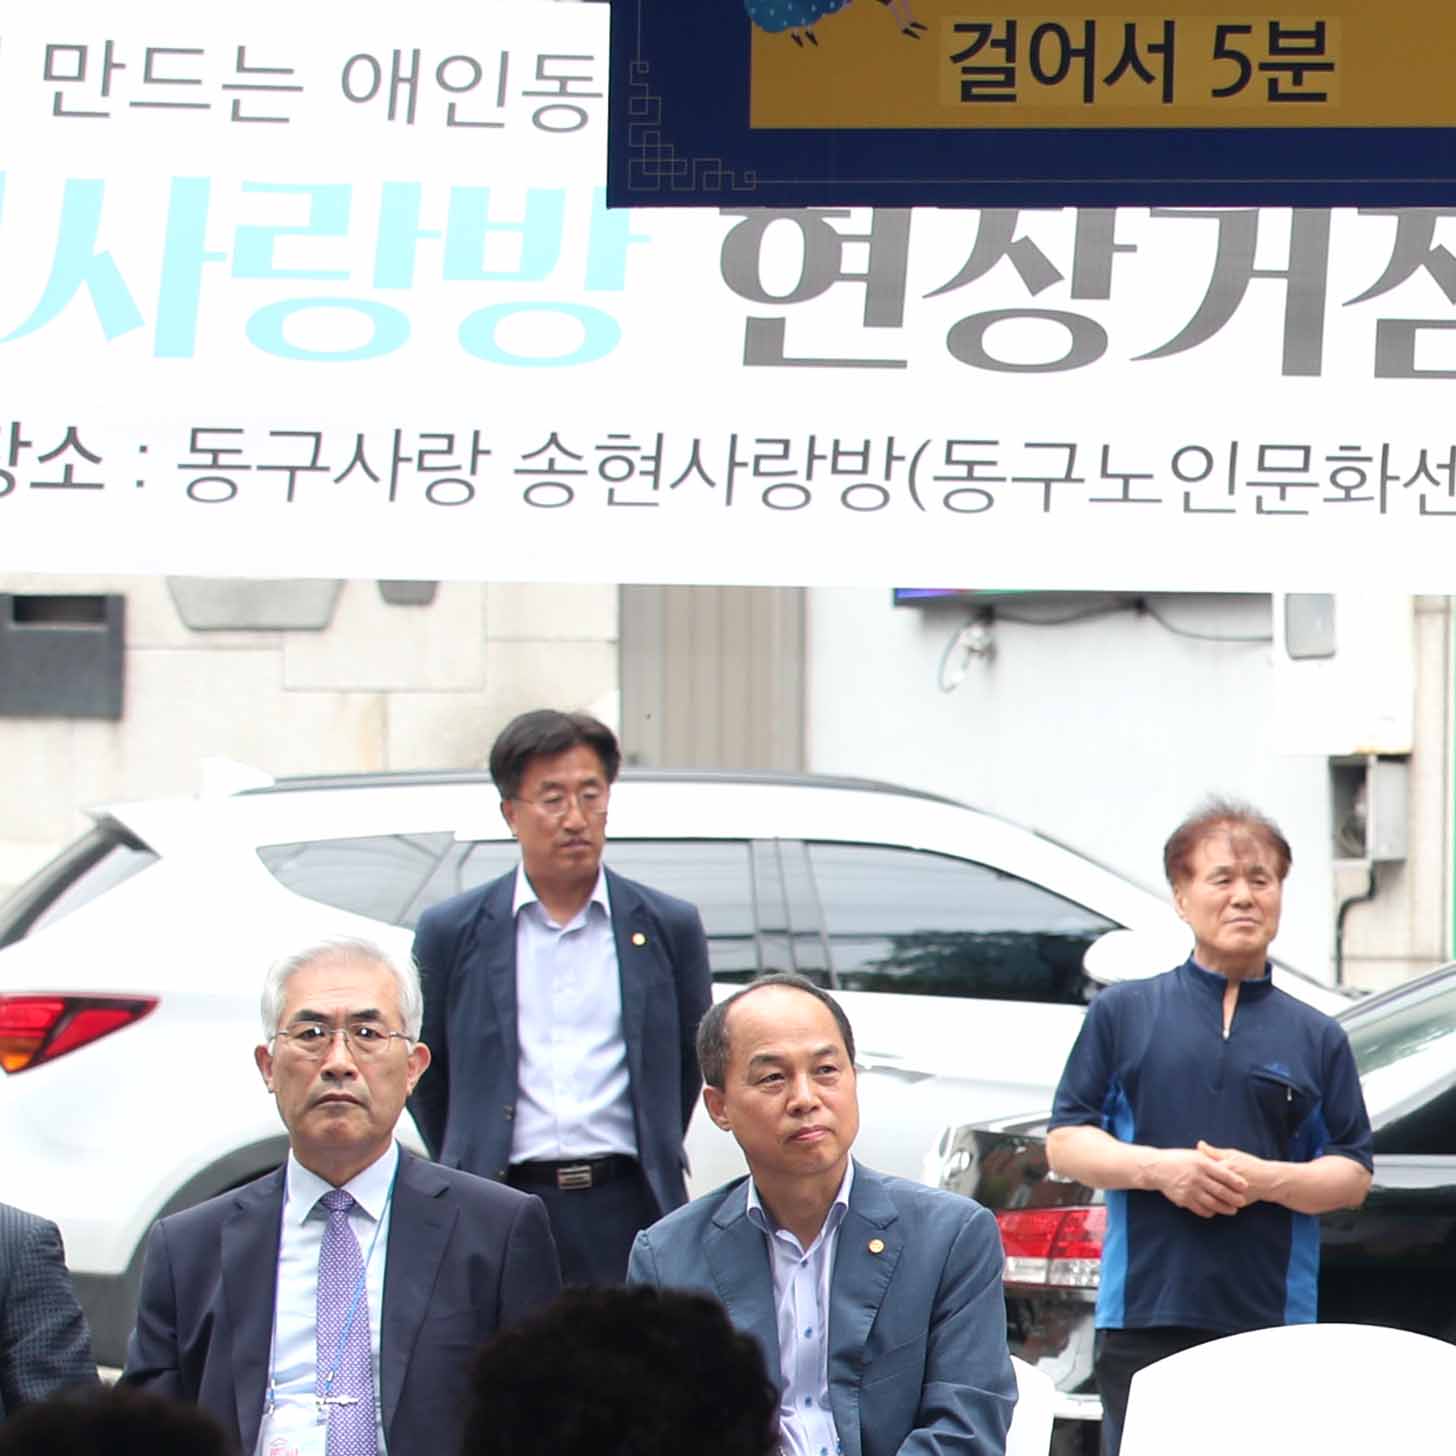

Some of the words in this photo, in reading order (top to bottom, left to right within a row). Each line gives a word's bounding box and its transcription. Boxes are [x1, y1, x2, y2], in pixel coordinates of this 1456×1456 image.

[43, 40, 304, 123] 만드는
[342, 49, 603, 132] 애인동
[946, 21, 1178, 105] 걸어서
[1209, 21, 1338, 105] 5분
[0, 172, 650, 366] 사랑방
[177, 428, 492, 506] 동구사랑
